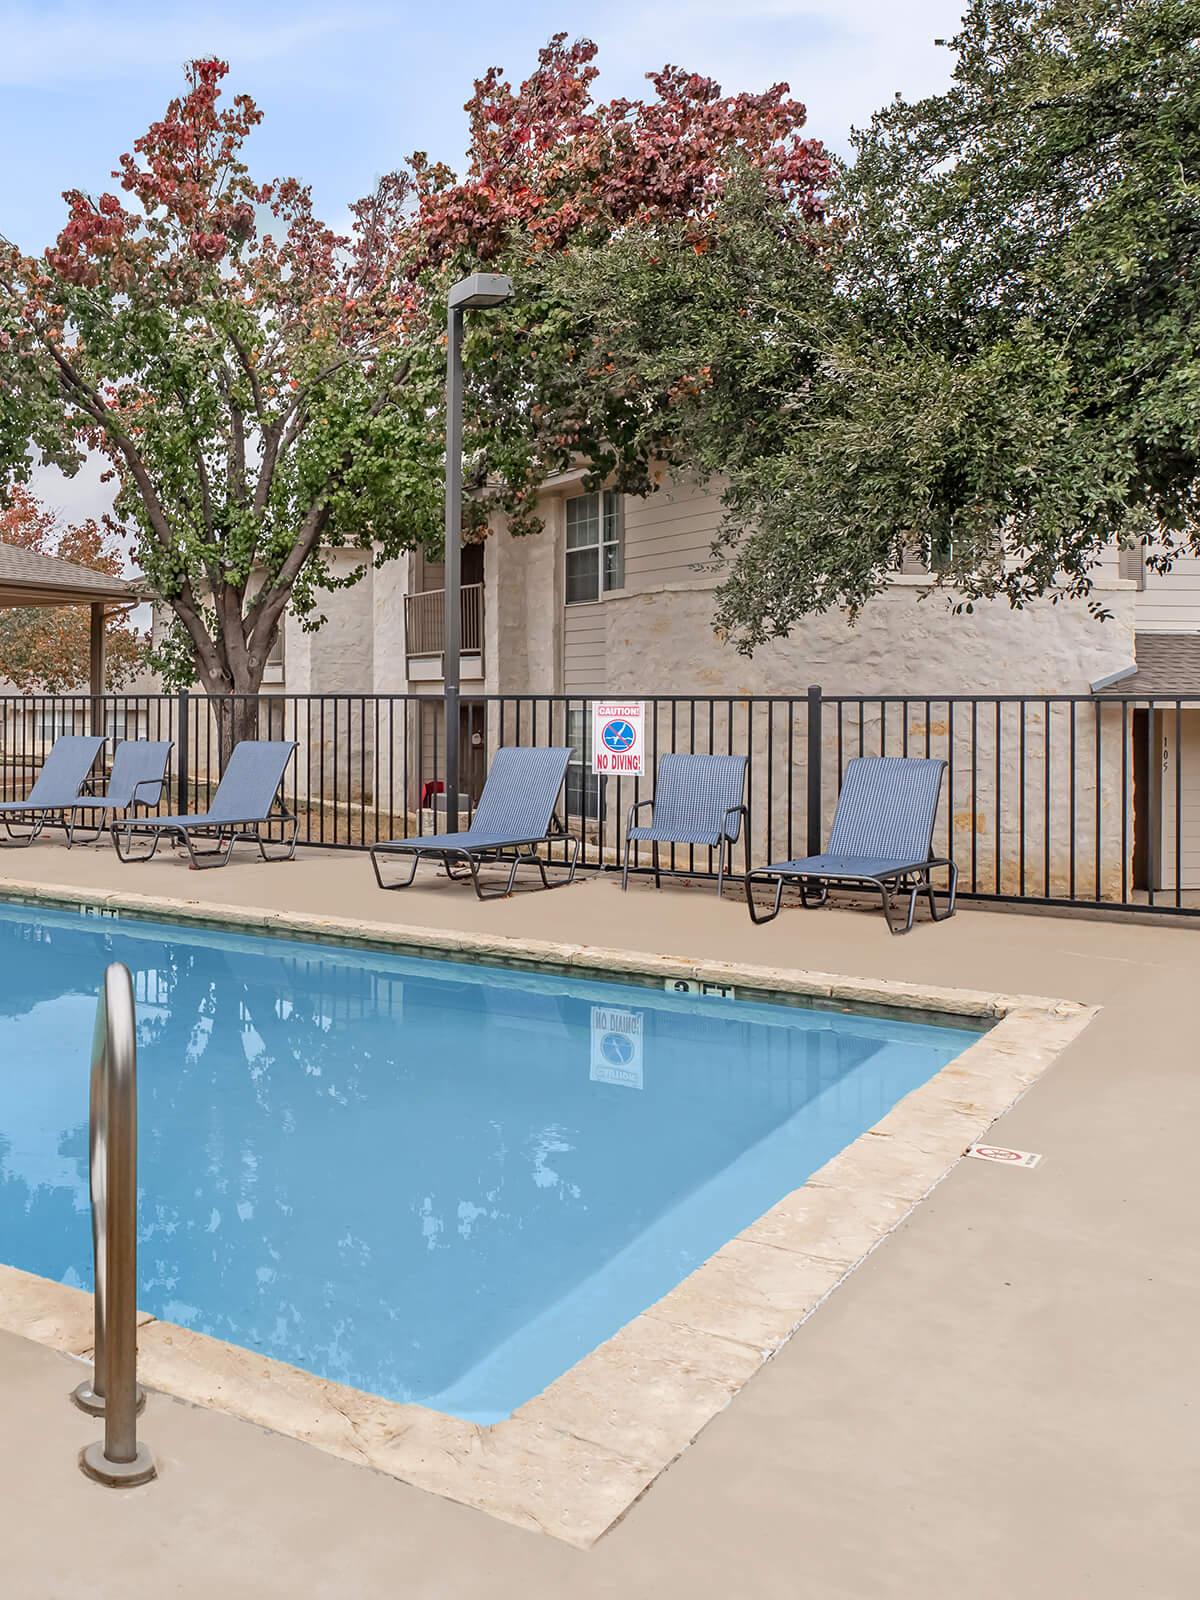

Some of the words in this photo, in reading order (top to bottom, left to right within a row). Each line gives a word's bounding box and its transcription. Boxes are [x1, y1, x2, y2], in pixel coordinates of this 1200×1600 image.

[599, 707, 640, 716] CAUTION!
[597, 754, 608, 769] NO
[611, 754, 640, 770] DIVING!
